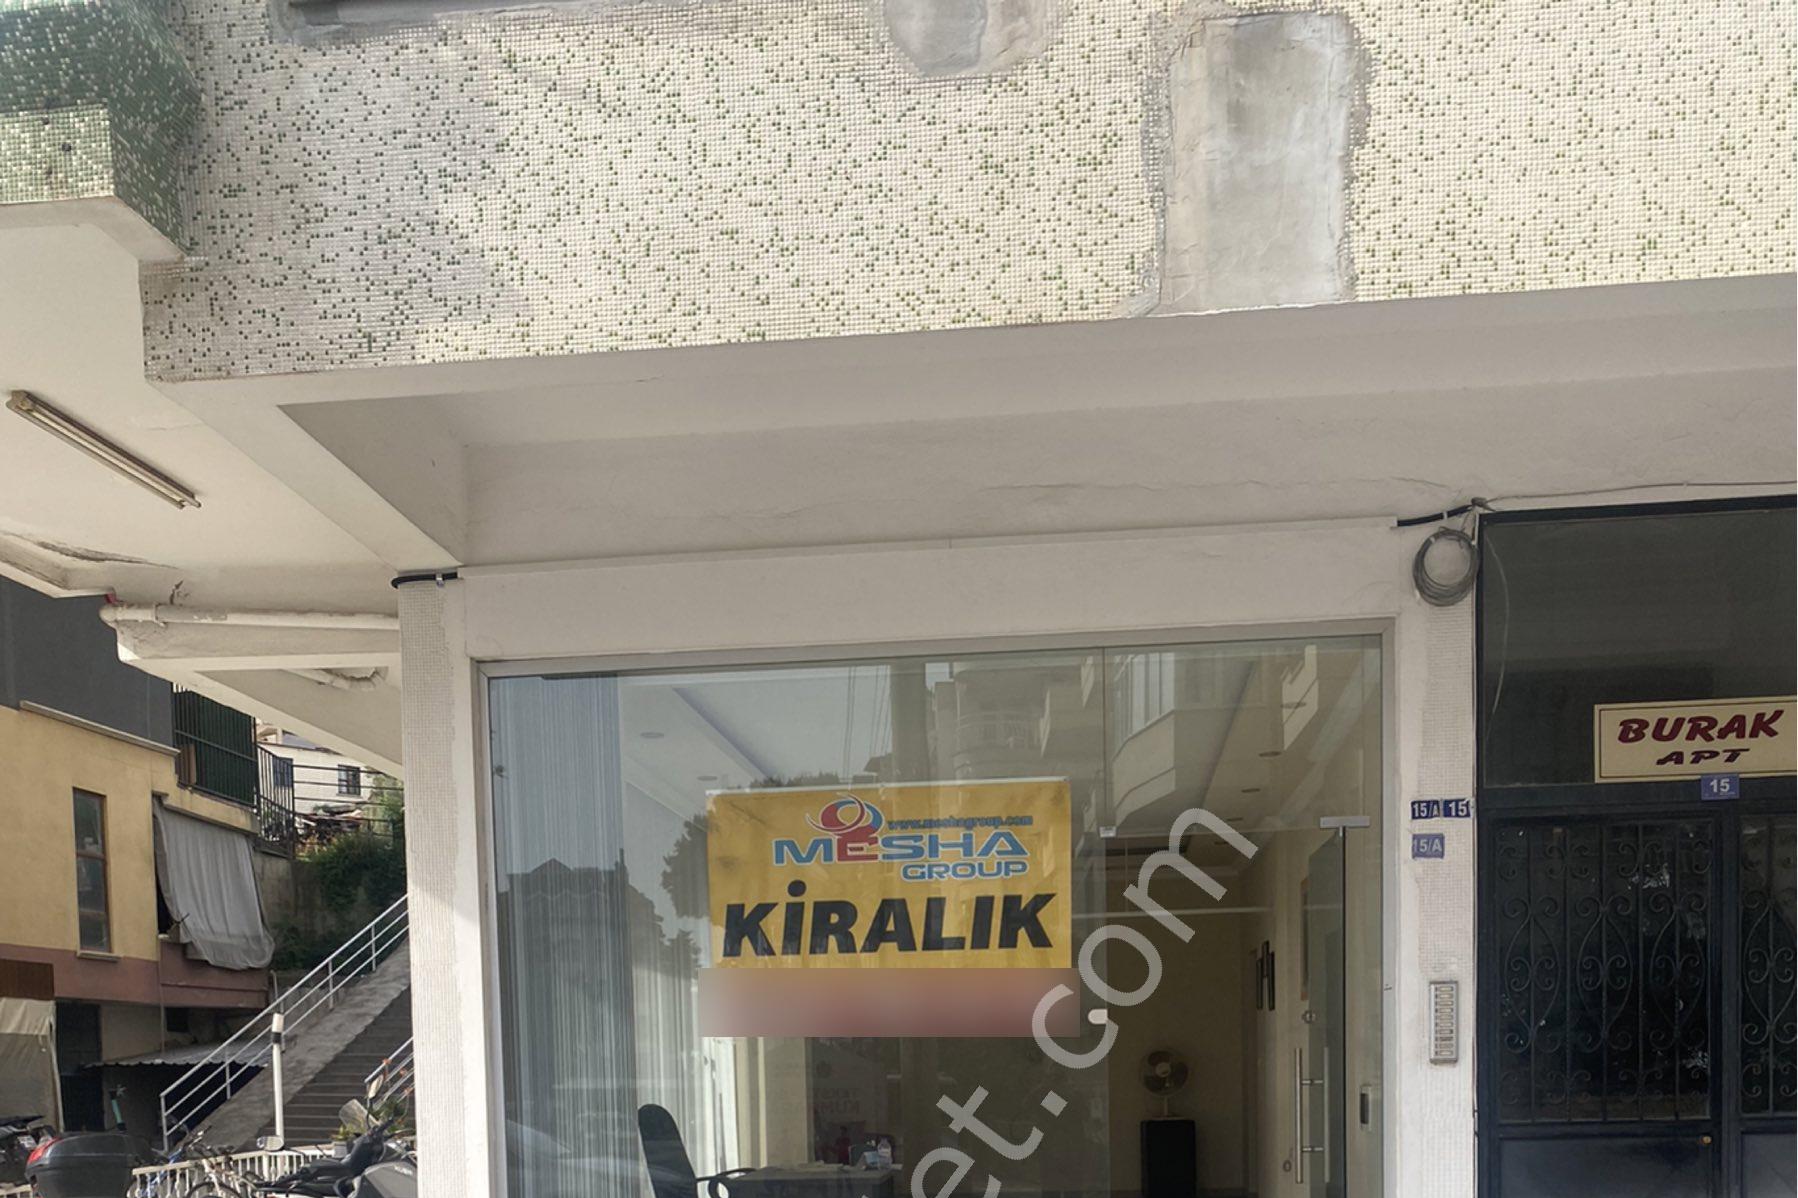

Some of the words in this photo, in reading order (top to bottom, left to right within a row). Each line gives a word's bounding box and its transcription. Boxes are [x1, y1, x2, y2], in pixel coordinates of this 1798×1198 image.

[1617, 709, 1785, 744] BURAK
[1656, 748, 1751, 766] APT
[1709, 778, 1731, 794] 15
[1412, 801, 1440, 818] 15/A
[1448, 801, 1468, 817] 15
[773, 830, 1031, 867] MESHA
[1412, 837, 1443, 854] 15/A
[902, 860, 1029, 881] GROUP
[722, 879, 1057, 958] KİRALIK
